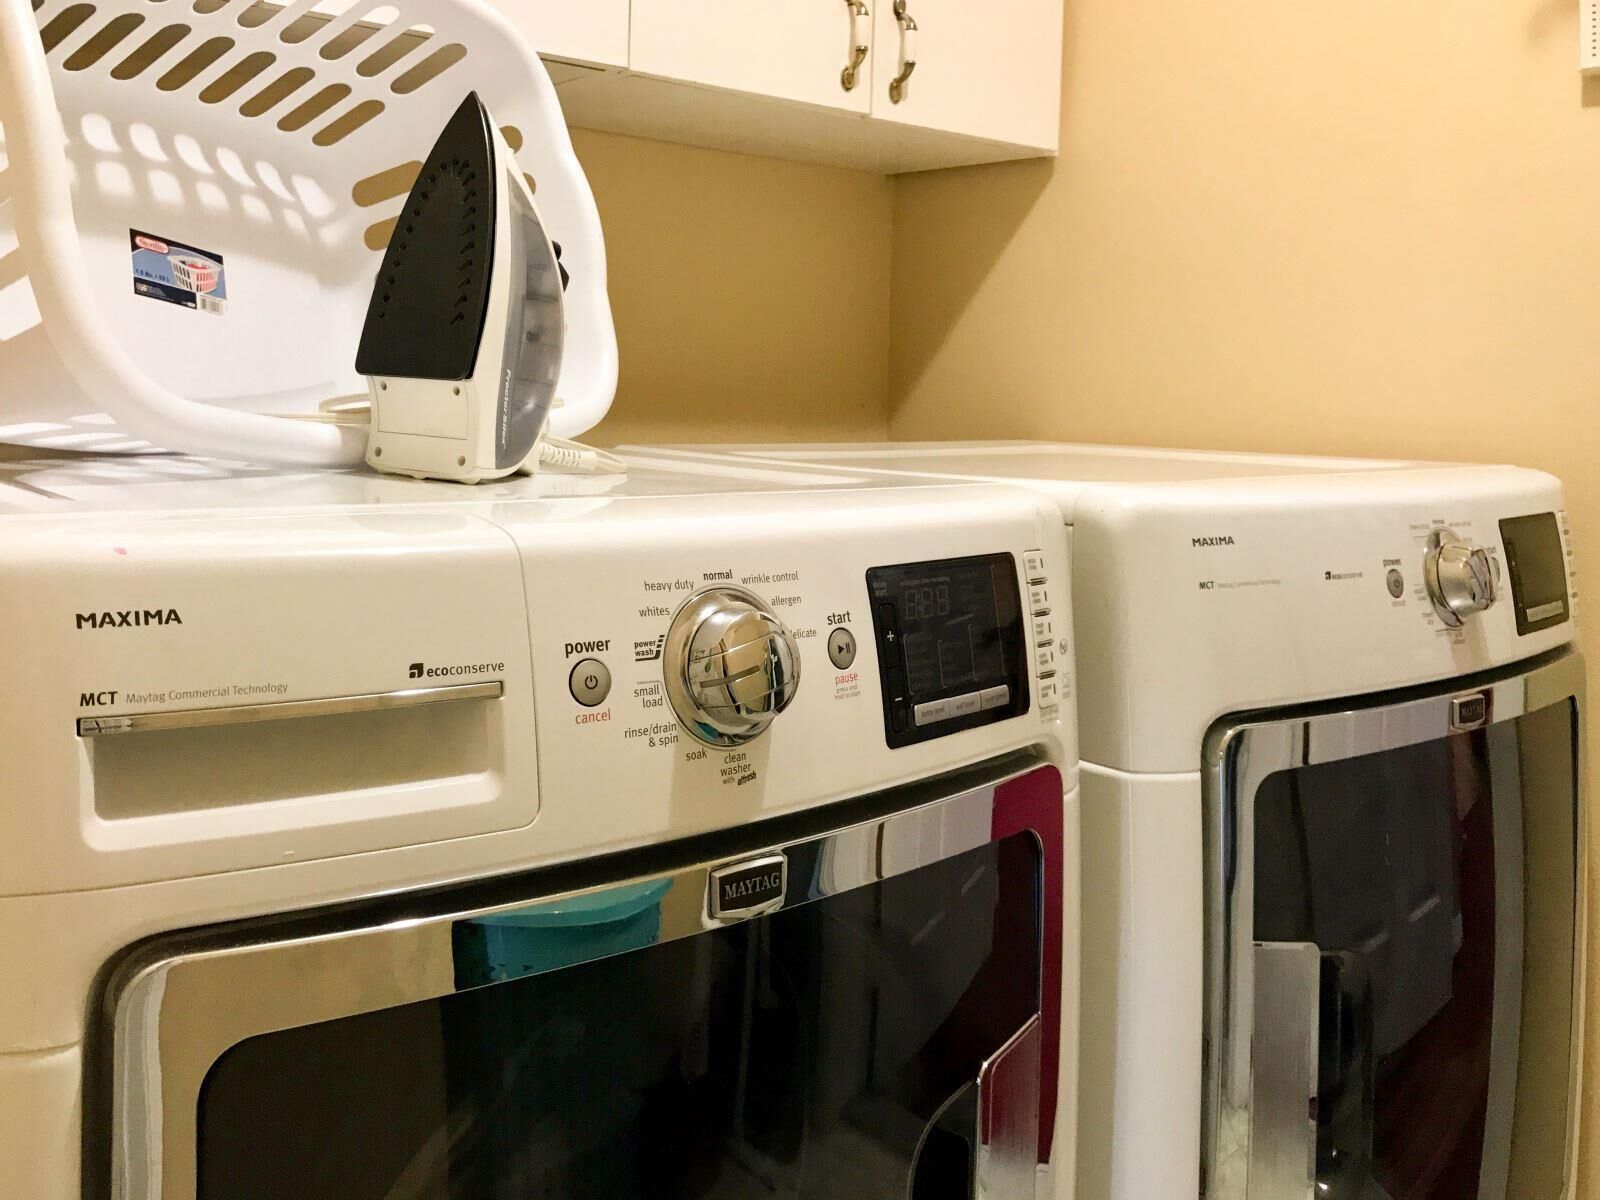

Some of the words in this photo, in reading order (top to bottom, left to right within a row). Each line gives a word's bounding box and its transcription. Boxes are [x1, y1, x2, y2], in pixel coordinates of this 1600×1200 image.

[1192, 536, 1235, 547] MAXIMA
[703, 569, 733, 581] normal
[741, 573, 770, 585] wrinkle
[772, 571, 799, 583] control
[644, 580, 672, 593] heavy
[674, 579, 694, 592] duty
[1199, 581, 1214, 589] MCT
[771, 595, 801, 608] allergen
[639, 605, 670, 617] whites
[827, 610, 851, 625] start
[75, 608, 183, 629] MAXIMA
[790, 628, 817, 639] elicate
[565, 637, 611, 659] power
[634, 640, 656, 650] power
[635, 648, 654, 657] wash
[426, 660, 505, 678] ecoconserve
[835, 673, 858, 686] pause
[126, 690, 166, 705] Maytag
[168, 684, 230, 700] Commercial
[232, 681, 289, 698] Technology
[634, 684, 660, 698] small
[79, 691, 118, 707] MCT
[642, 697, 663, 708] load
[575, 709, 611, 725] cancel
[624, 721, 677, 739] rinse/drain
[648, 737, 656, 747] &
[658, 734, 679, 749] spin
[686, 748, 708, 762] soak
[724, 752, 747, 764] clean
[720, 763, 751, 776] washer
[722, 776, 736, 784] with
[724, 872, 780, 900] MAYTAG
